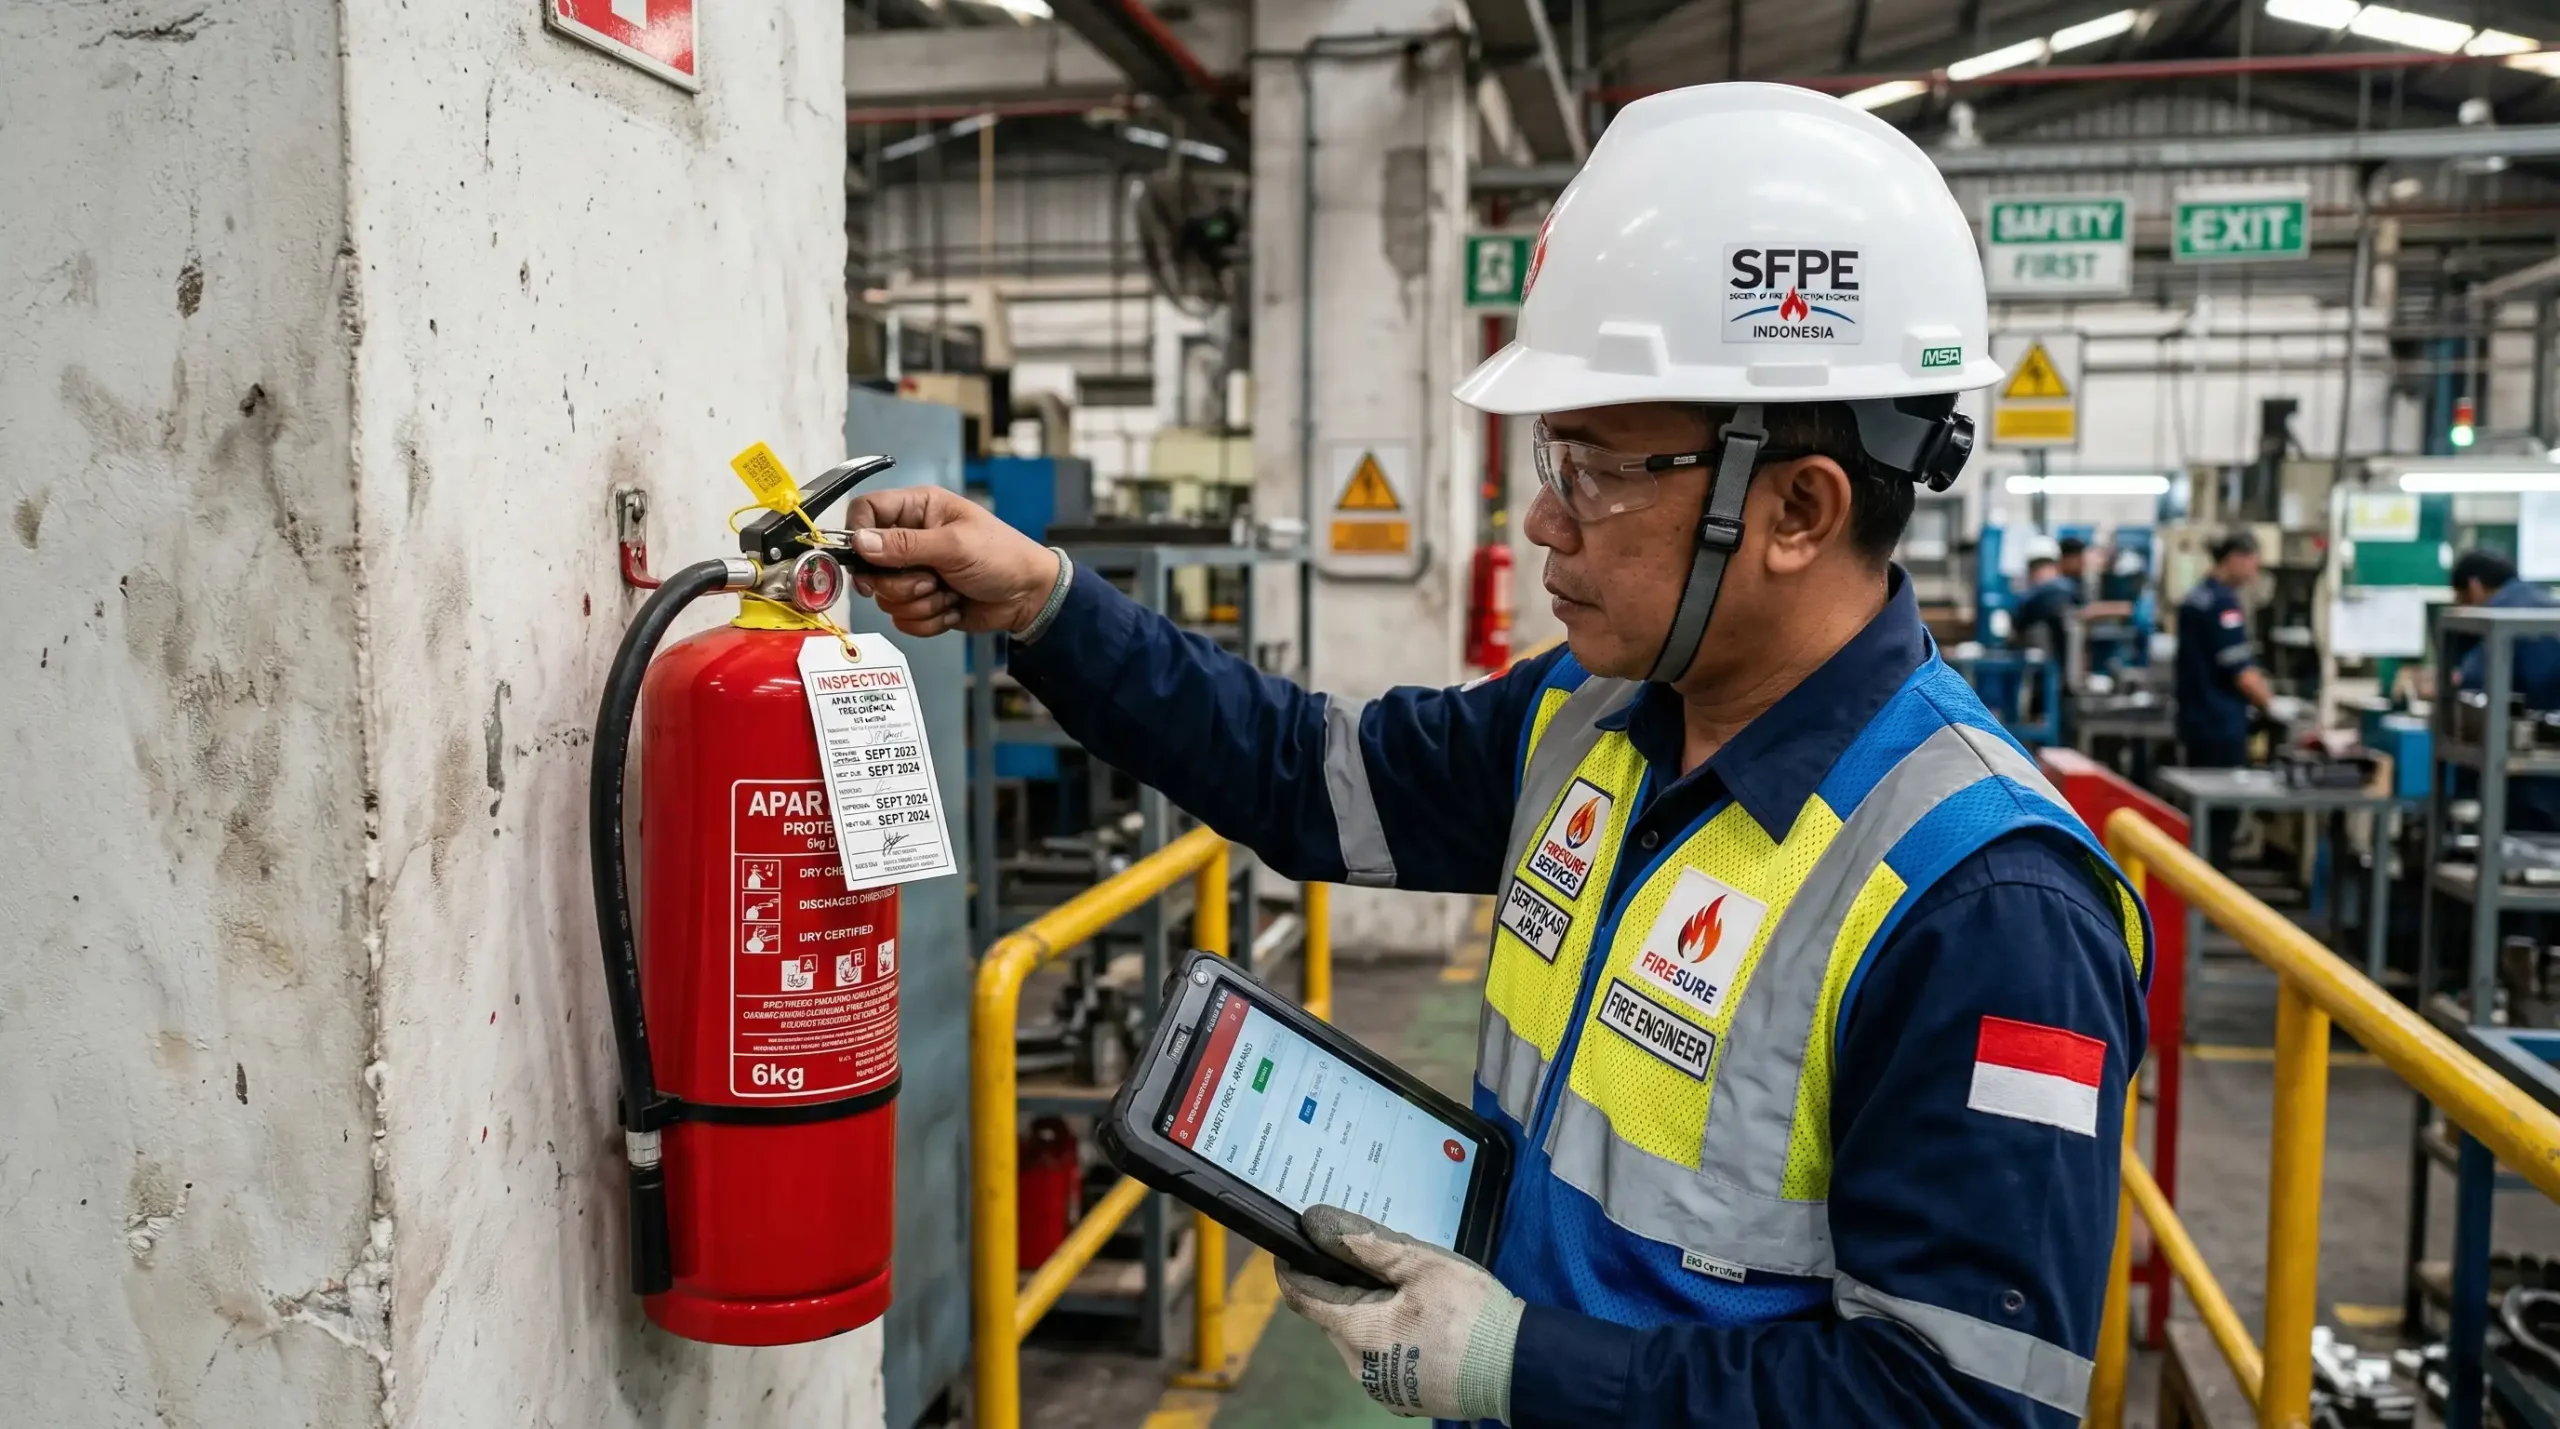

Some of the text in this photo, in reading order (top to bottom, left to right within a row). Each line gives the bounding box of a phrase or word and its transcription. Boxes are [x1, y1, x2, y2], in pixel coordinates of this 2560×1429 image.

[1998, 203, 2118, 239] SAFETY
[2190, 206, 2292, 250] EXIT
[1729, 248, 1859, 290] SFPE
[2014, 252, 2098, 280] FIRST
[1753, 325, 1834, 339] INDONESIA
[1923, 348, 1960, 366] MSA
[816, 671, 902, 690] INSPECTION
[865, 748, 891, 760] SEPT
[894, 745, 917, 757] 2023
[868, 762, 920, 777] SEPT 2024
[748, 790, 823, 817] APAR
[876, 796, 902, 809] SEPT
[905, 793, 928, 805] 2024
[878, 809, 930, 826] SEPT 2024
[799, 867, 822, 878] DRY
[1511, 886, 1568, 938] SERTIFIKASI
[824, 924, 874, 940] CERTIFIED
[1515, 915, 1544, 945] APAR
[1641, 950, 1718, 1006] FIRESURE
[1605, 991, 1707, 1069] FIRE ENGINEER
[752, 1063, 804, 1090] 6kg
